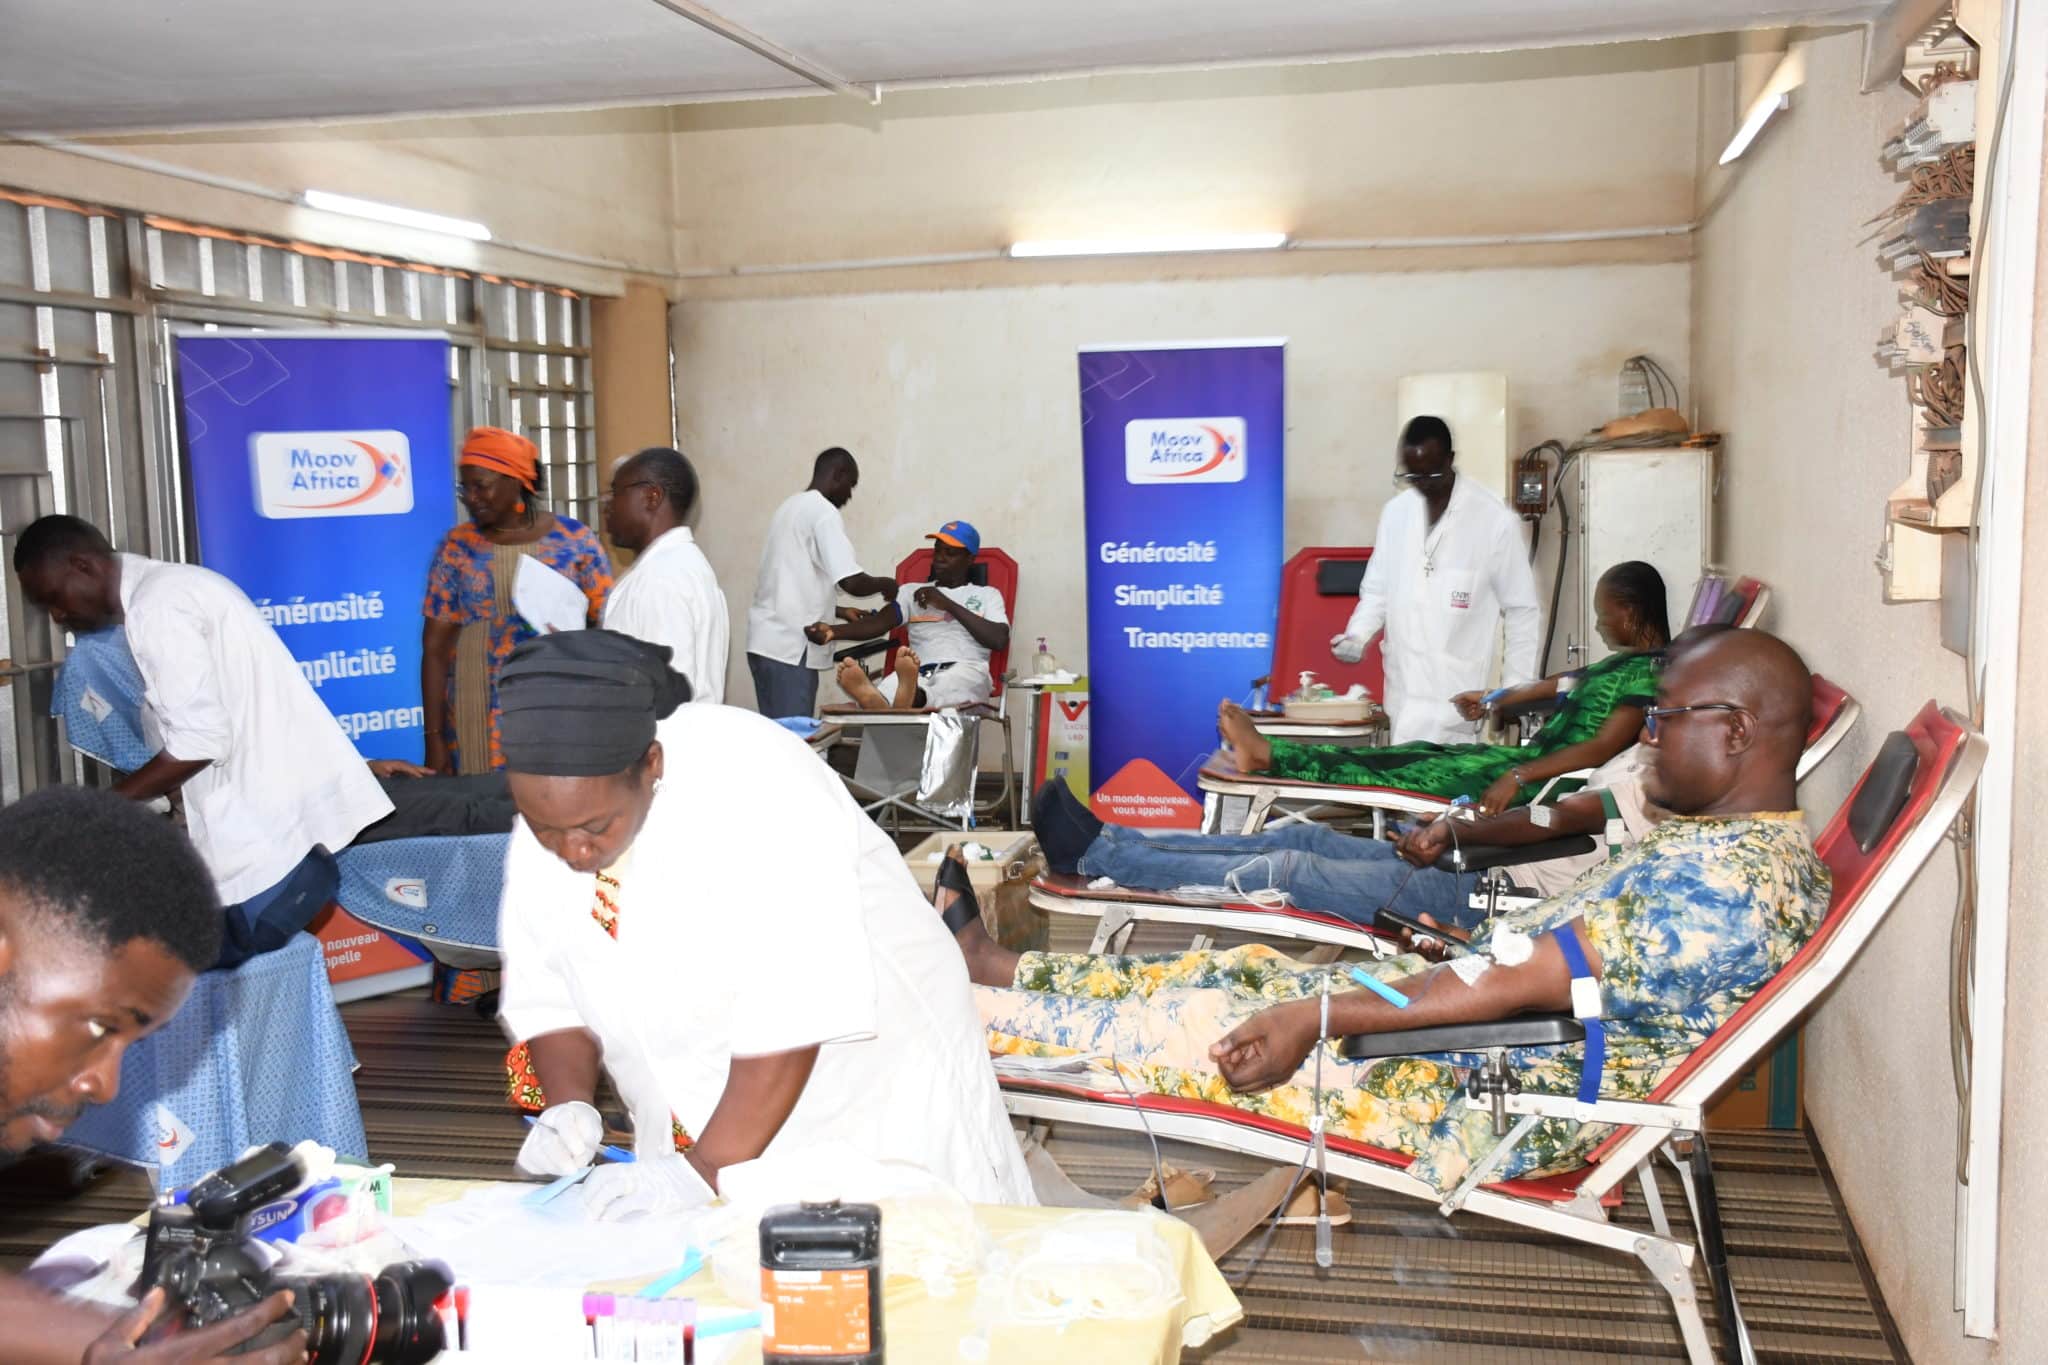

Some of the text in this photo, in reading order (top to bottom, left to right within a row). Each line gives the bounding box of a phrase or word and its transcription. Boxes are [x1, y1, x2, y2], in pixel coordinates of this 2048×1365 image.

[1150, 431, 1202, 447] Moov
[290, 448, 358, 469] Moov
[1149, 448, 1204, 463] Africa
[291, 470, 361, 491] Africa
[1100, 541, 1218, 563] Générosité
[1114, 583, 1225, 611] Simplicité
[260, 591, 384, 626] énérosité
[1122, 626, 1271, 653] Transparence
[298, 646, 397, 688] plicité
[336, 706, 424, 740] sparen
[1096, 793, 1191, 805] Un monde nouveau
[1112, 805, 1175, 817] vous appelle
[327, 931, 380, 951] nouveau
[324, 950, 362, 969] pelle
